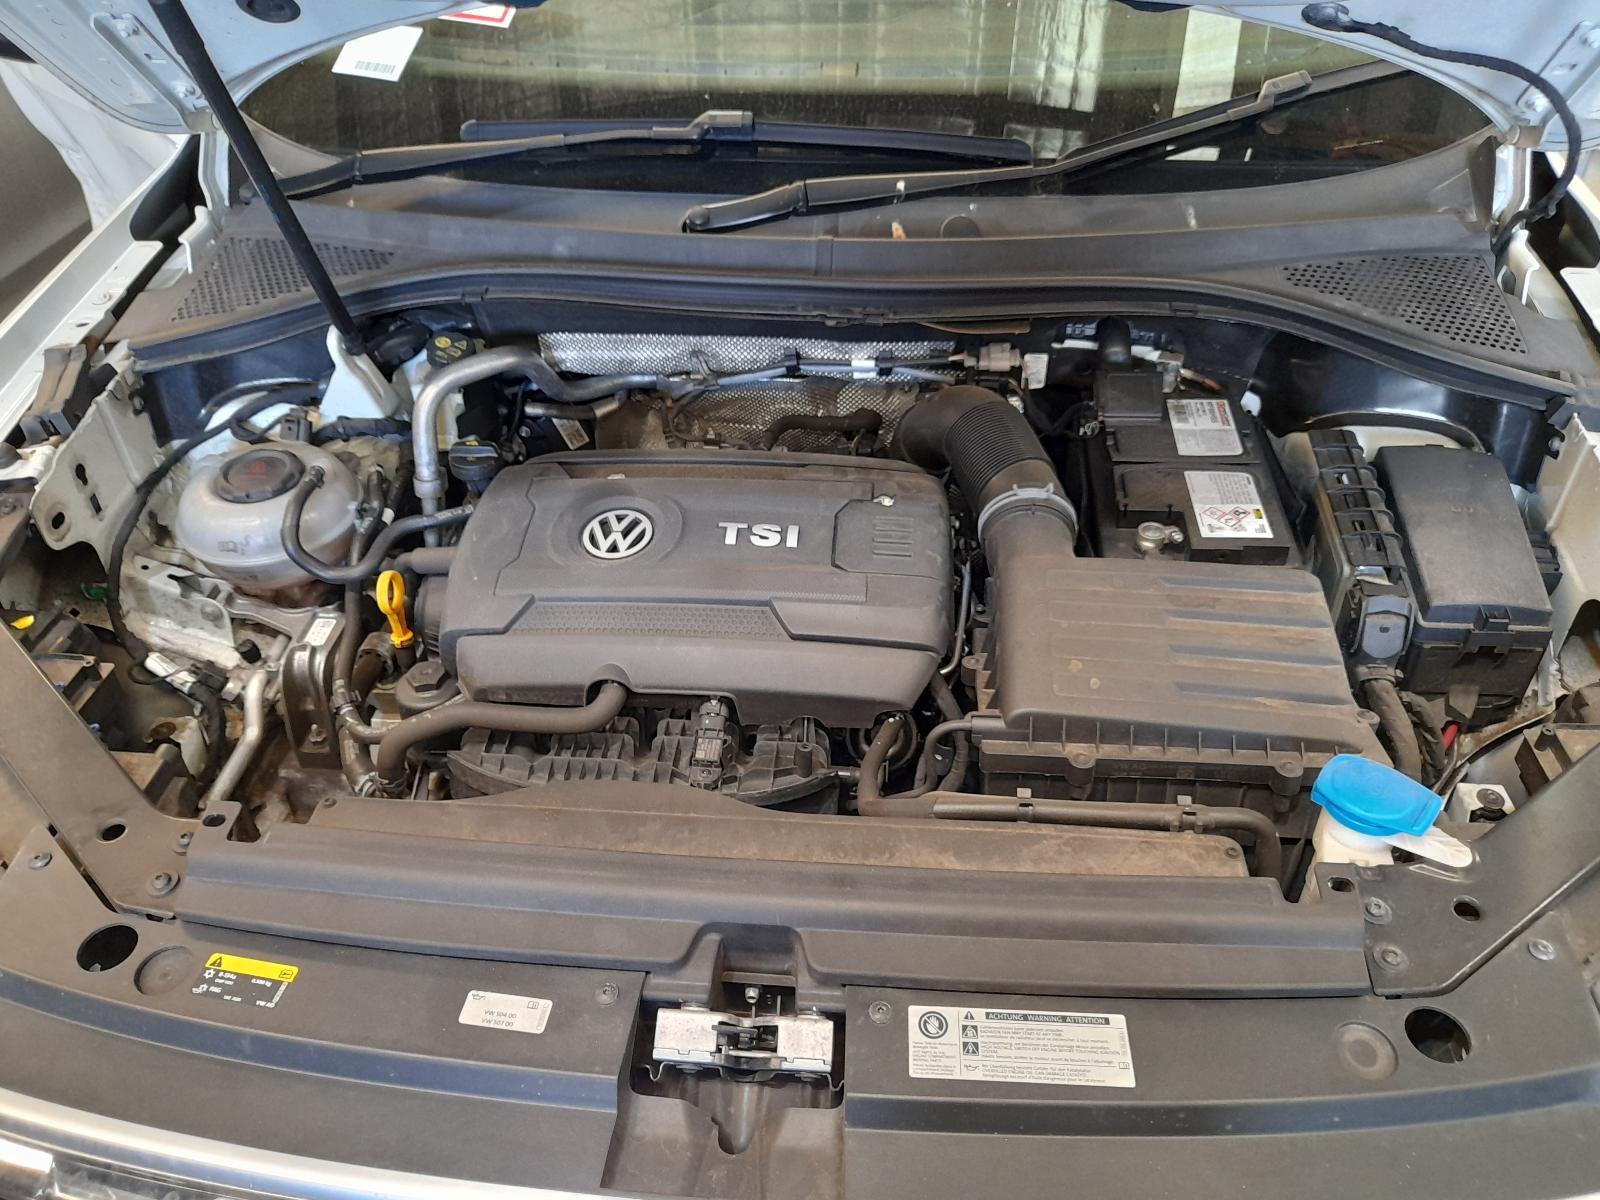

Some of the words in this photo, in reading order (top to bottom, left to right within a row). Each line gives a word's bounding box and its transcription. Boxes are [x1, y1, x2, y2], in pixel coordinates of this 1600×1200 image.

[582, 509, 653, 560] VW
[718, 521, 800, 549] TSI
[484, 1008, 495, 1016] VW
[988, 1012, 1024, 1021] ACHTUNG
[1026, 1014, 1063, 1023] WARNING
[1065, 1016, 1106, 1025] ATTENTION
